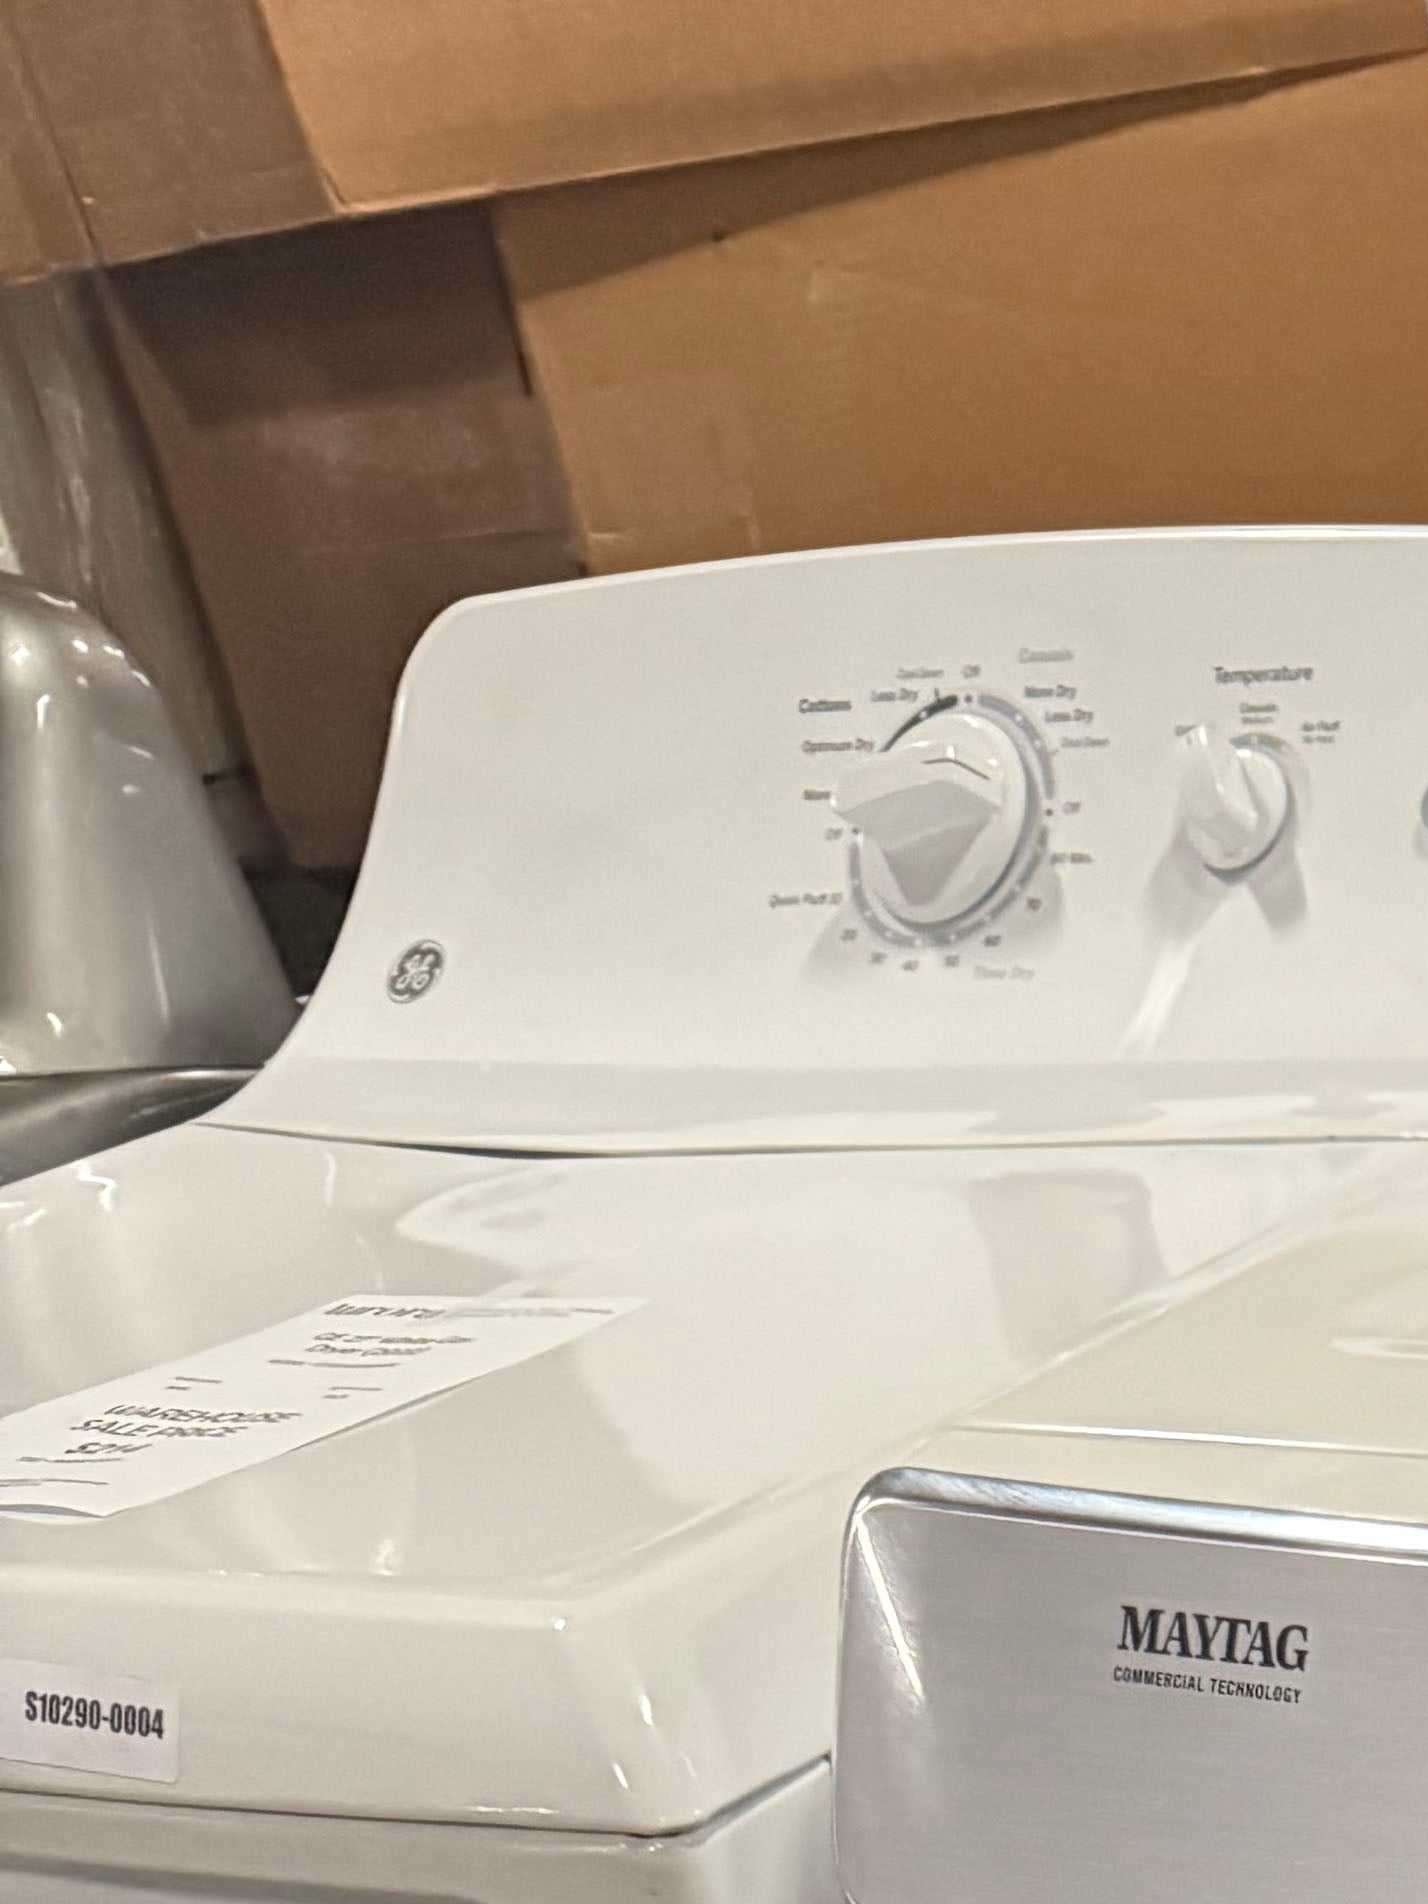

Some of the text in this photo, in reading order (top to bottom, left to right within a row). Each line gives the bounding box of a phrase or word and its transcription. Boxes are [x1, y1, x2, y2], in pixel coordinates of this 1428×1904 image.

[1214, 666, 1313, 685] Temperature
[104, 1403, 302, 1423] WAREHOUSE
[70, 1419, 248, 1437] SALE PRICE
[1117, 1605, 1309, 1671] MAYTAG
[1113, 1666, 1301, 1704] COMMERCIAL TECHNOLOGY
[25, 1690, 165, 1740] S10290-0004
